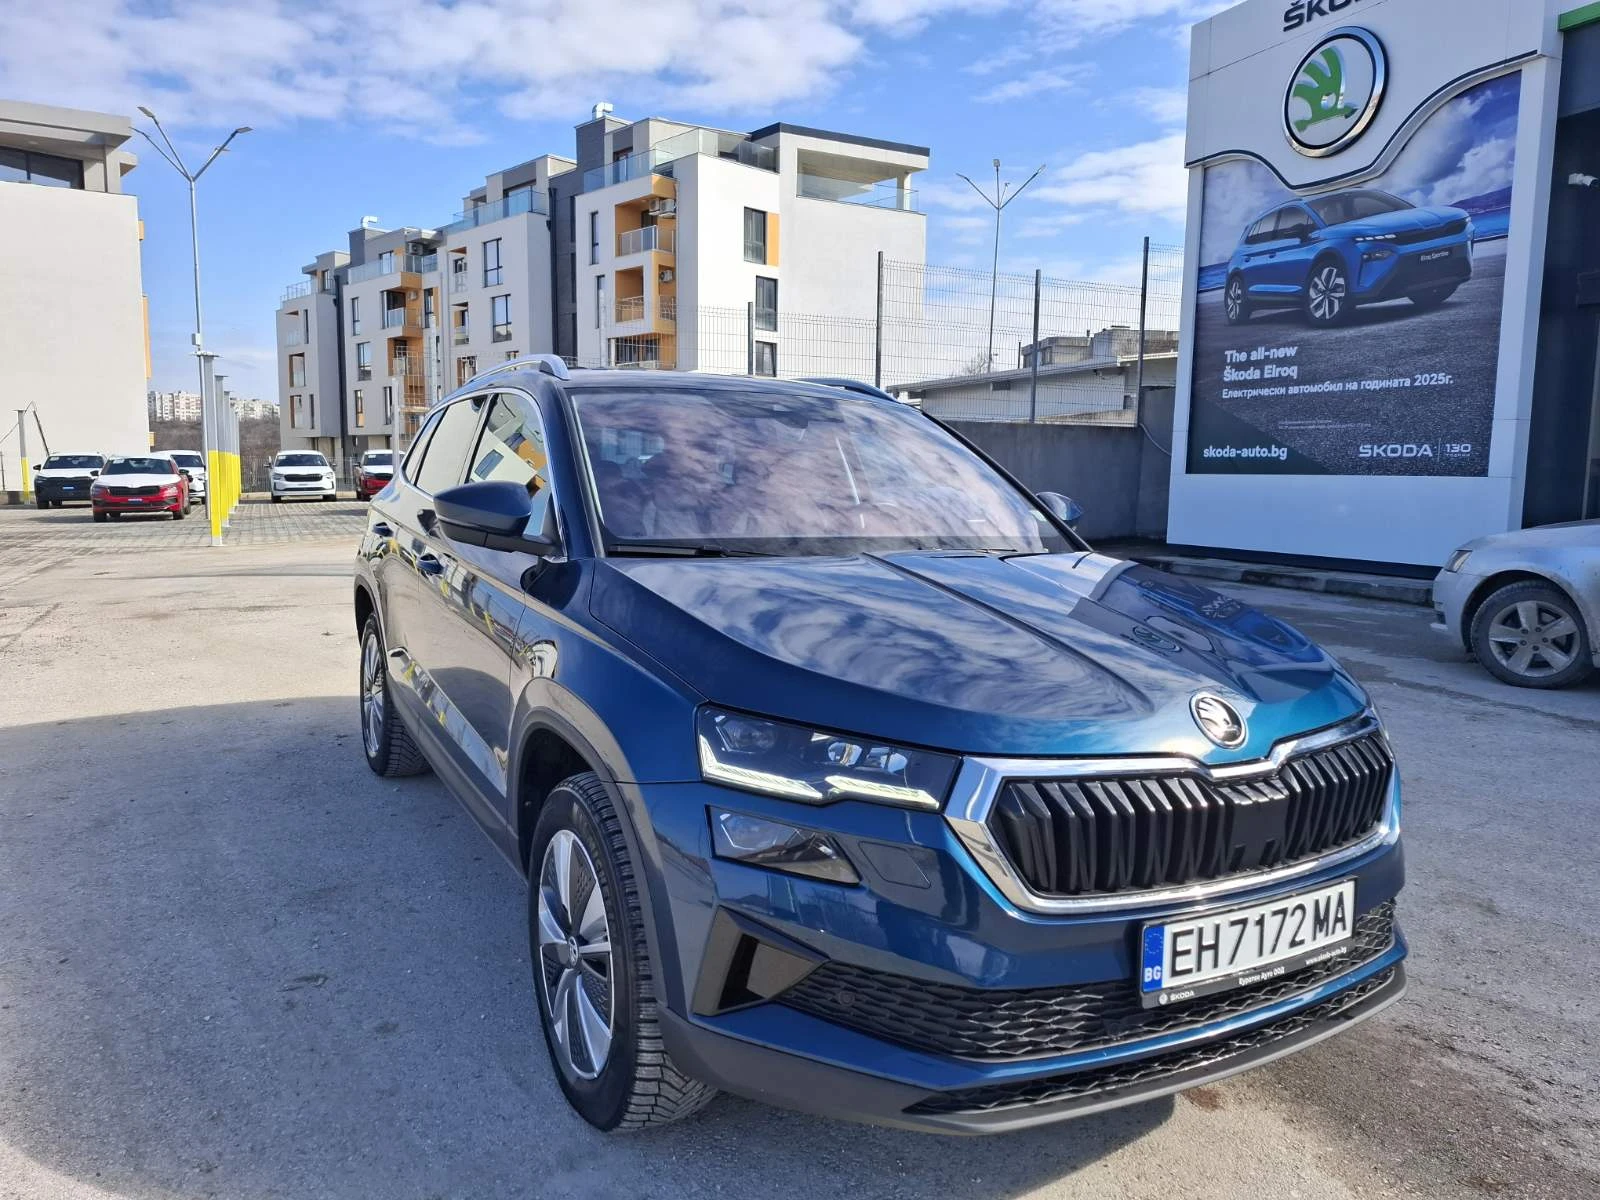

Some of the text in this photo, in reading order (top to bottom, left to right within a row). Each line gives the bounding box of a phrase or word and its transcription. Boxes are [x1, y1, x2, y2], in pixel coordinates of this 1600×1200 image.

[1282, 0, 1363, 32] ŠK
[1224, 346, 1298, 363] The all-new
[1223, 364, 1298, 382] Škoda Elroq
[1222, 373, 1454, 399] Електрически автомобил на годината 2025г.
[1203, 445, 1288, 461] skoda-auto.bg
[1445, 443, 1471, 453] 130
[1144, 965, 1162, 983] BG
